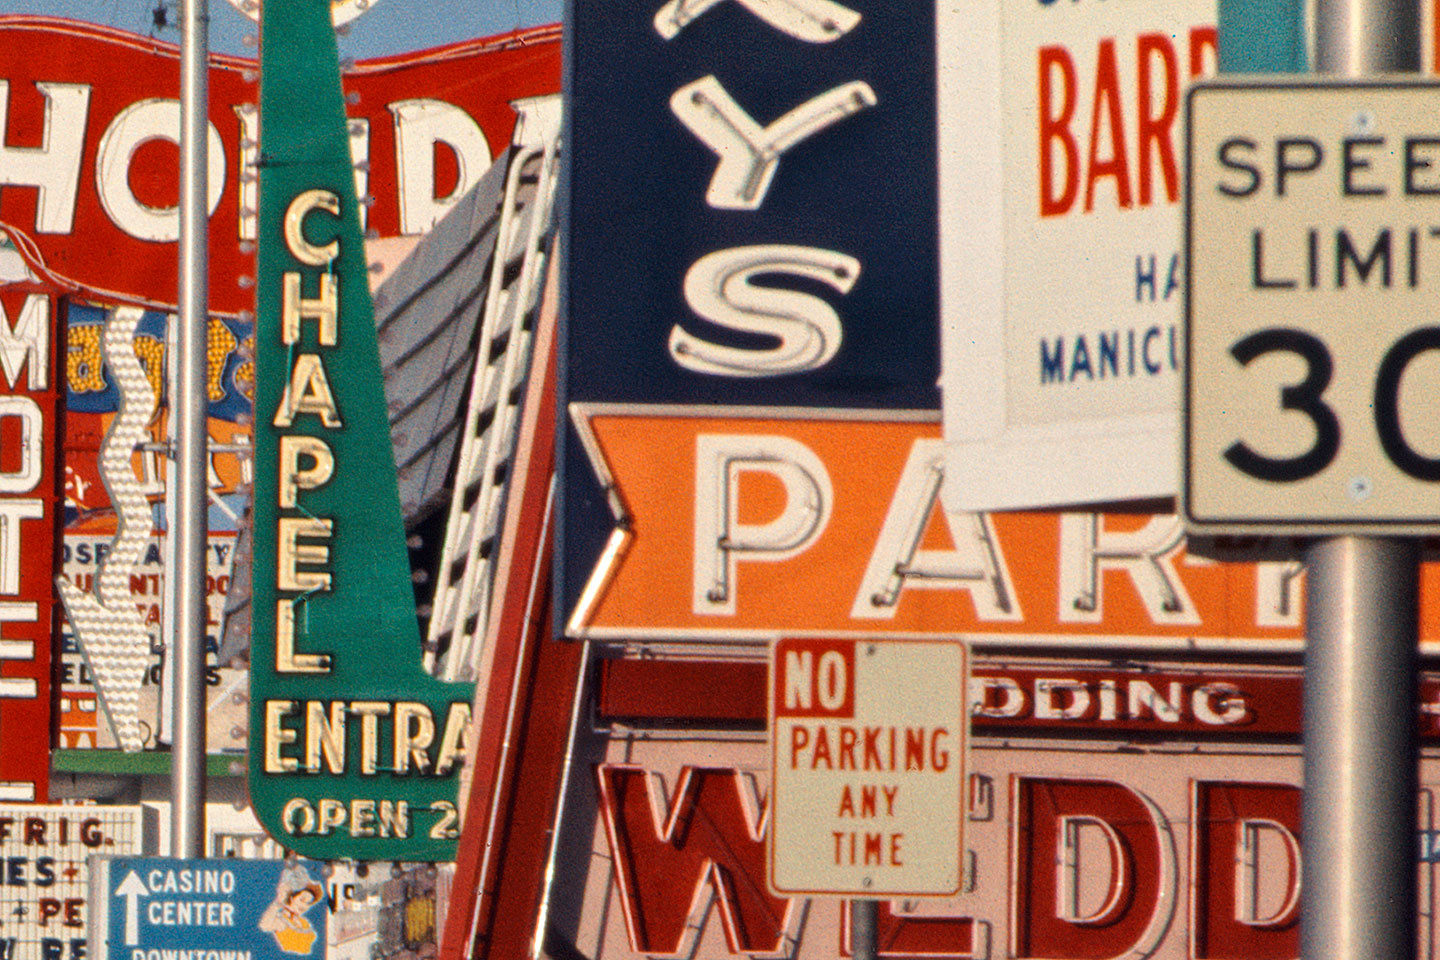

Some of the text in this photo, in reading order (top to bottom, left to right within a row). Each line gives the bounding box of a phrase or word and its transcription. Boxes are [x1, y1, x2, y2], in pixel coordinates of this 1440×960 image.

[1038, 26, 1217, 218] BAR
[1252, 228, 1440, 289] LIMI
[273, 189, 344, 673] CHAPEL
[786, 651, 846, 710] NO
[790, 726, 950, 771] PARKING
[282, 798, 409, 839] OPEN
[838, 785, 897, 818] ANY
[832, 832, 904, 868] TIME
[148, 869, 235, 894] CASINO
[148, 902, 235, 927] CENTER
